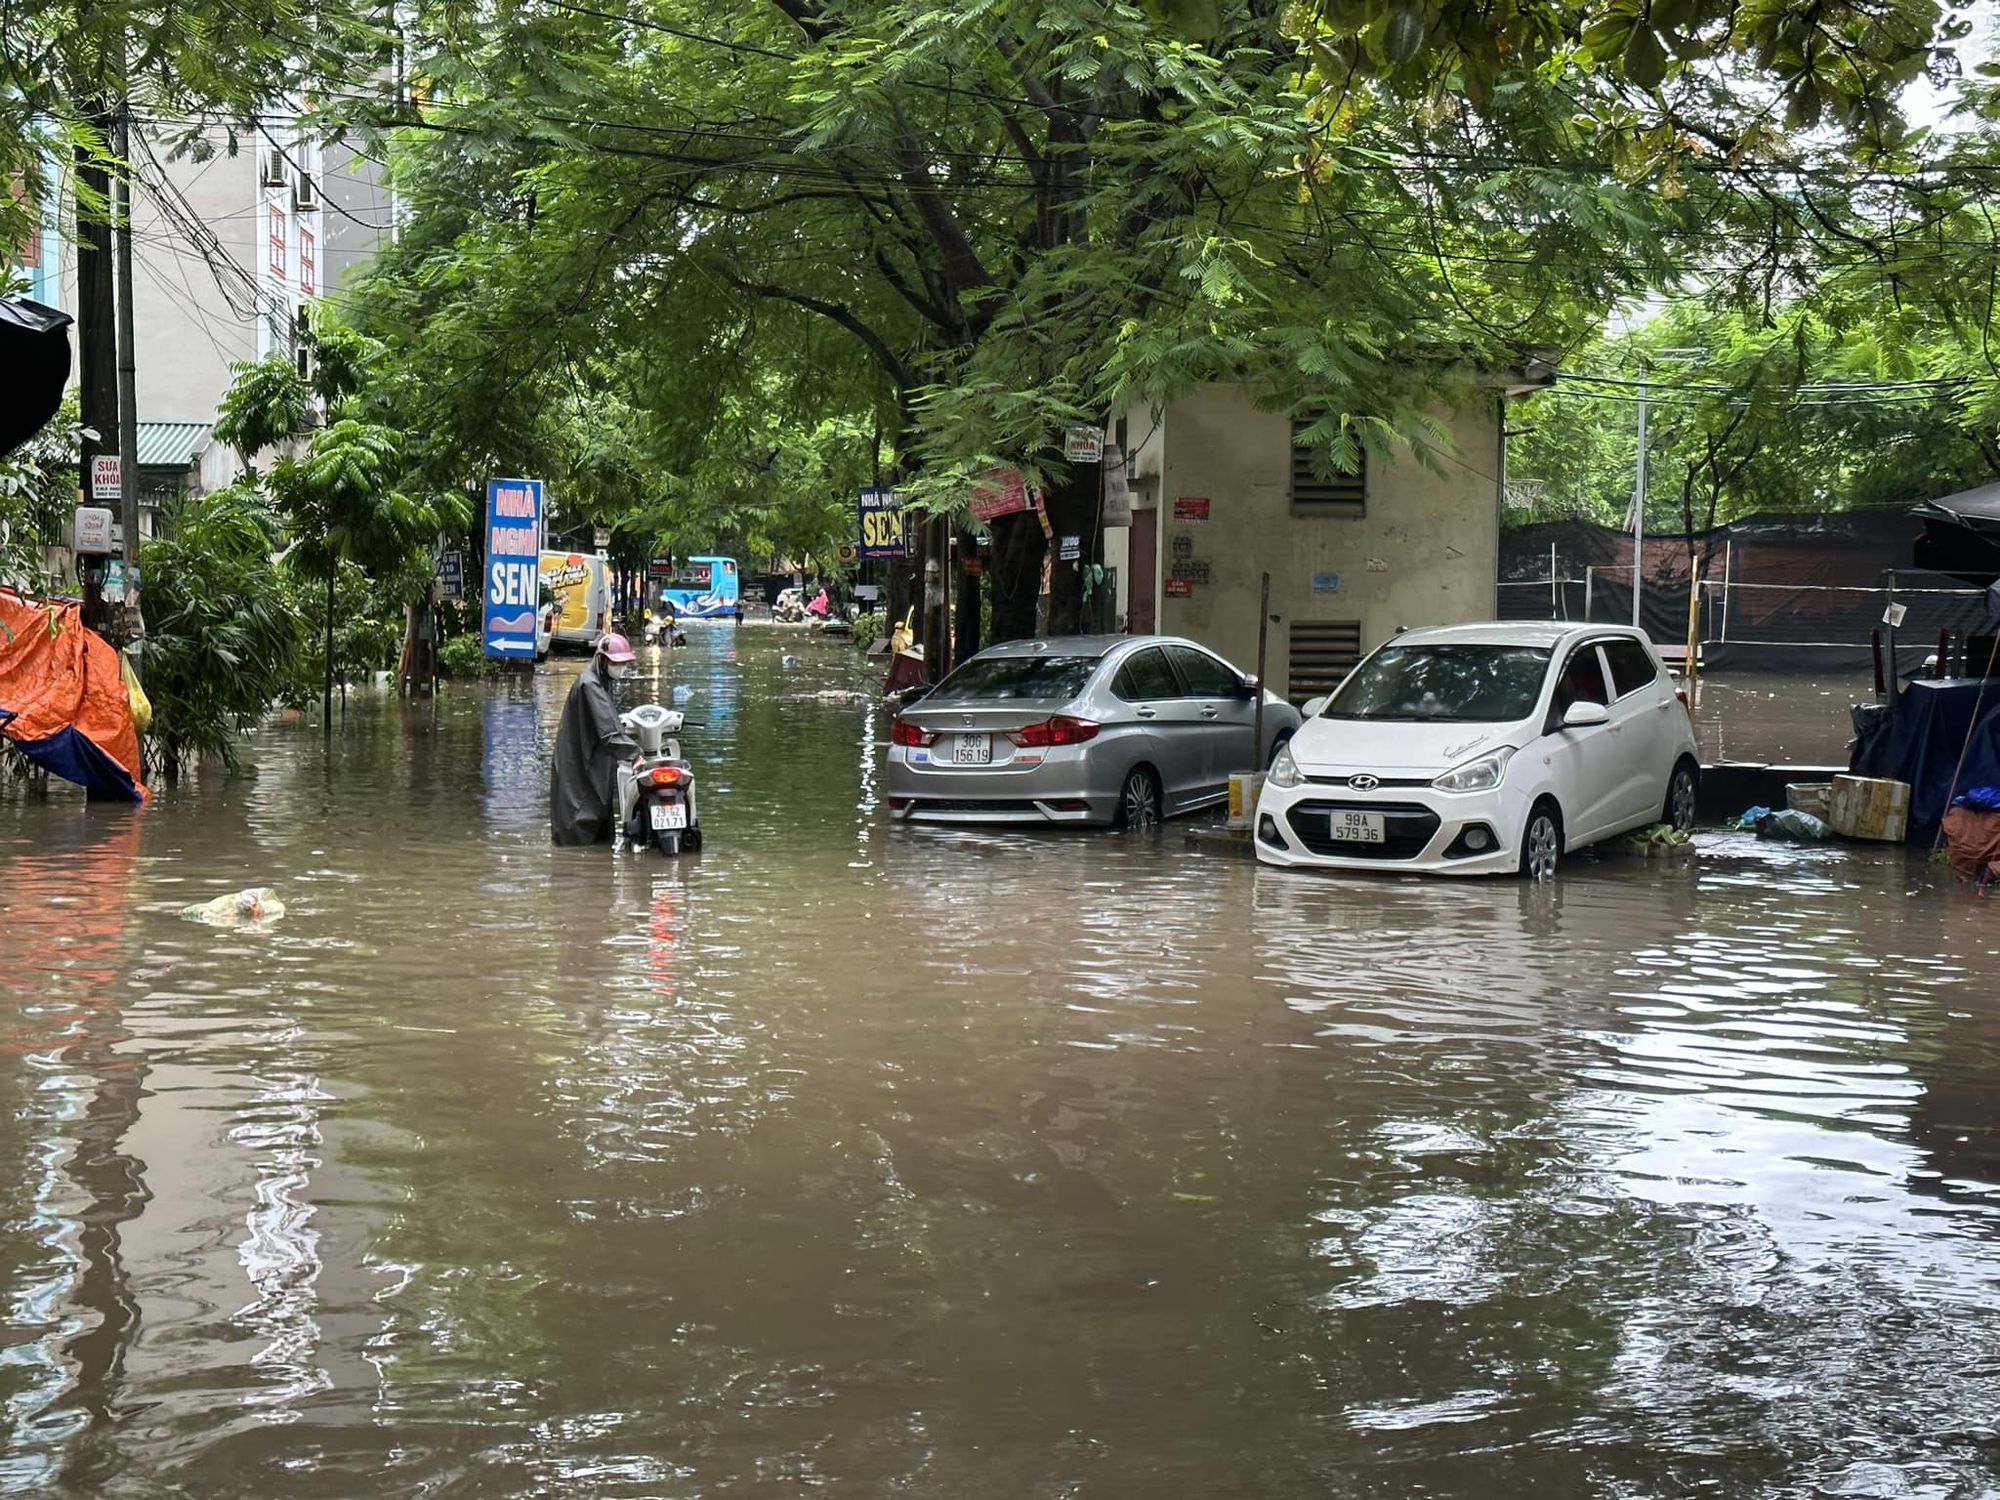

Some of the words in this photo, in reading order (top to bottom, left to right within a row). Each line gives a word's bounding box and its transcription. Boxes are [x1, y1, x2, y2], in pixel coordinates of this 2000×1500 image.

[496, 485, 536, 518] NHÀ
[861, 491, 880, 507] NHÀ
[863, 510, 904, 547] SEN
[491, 520, 538, 556] NGHỈ
[490, 562, 537, 606] SEN
[962, 735, 982, 748] 30G
[955, 749, 989, 762] 156.19
[1345, 813, 1368, 826] 98A
[1335, 826, 1379, 841] 579.36
